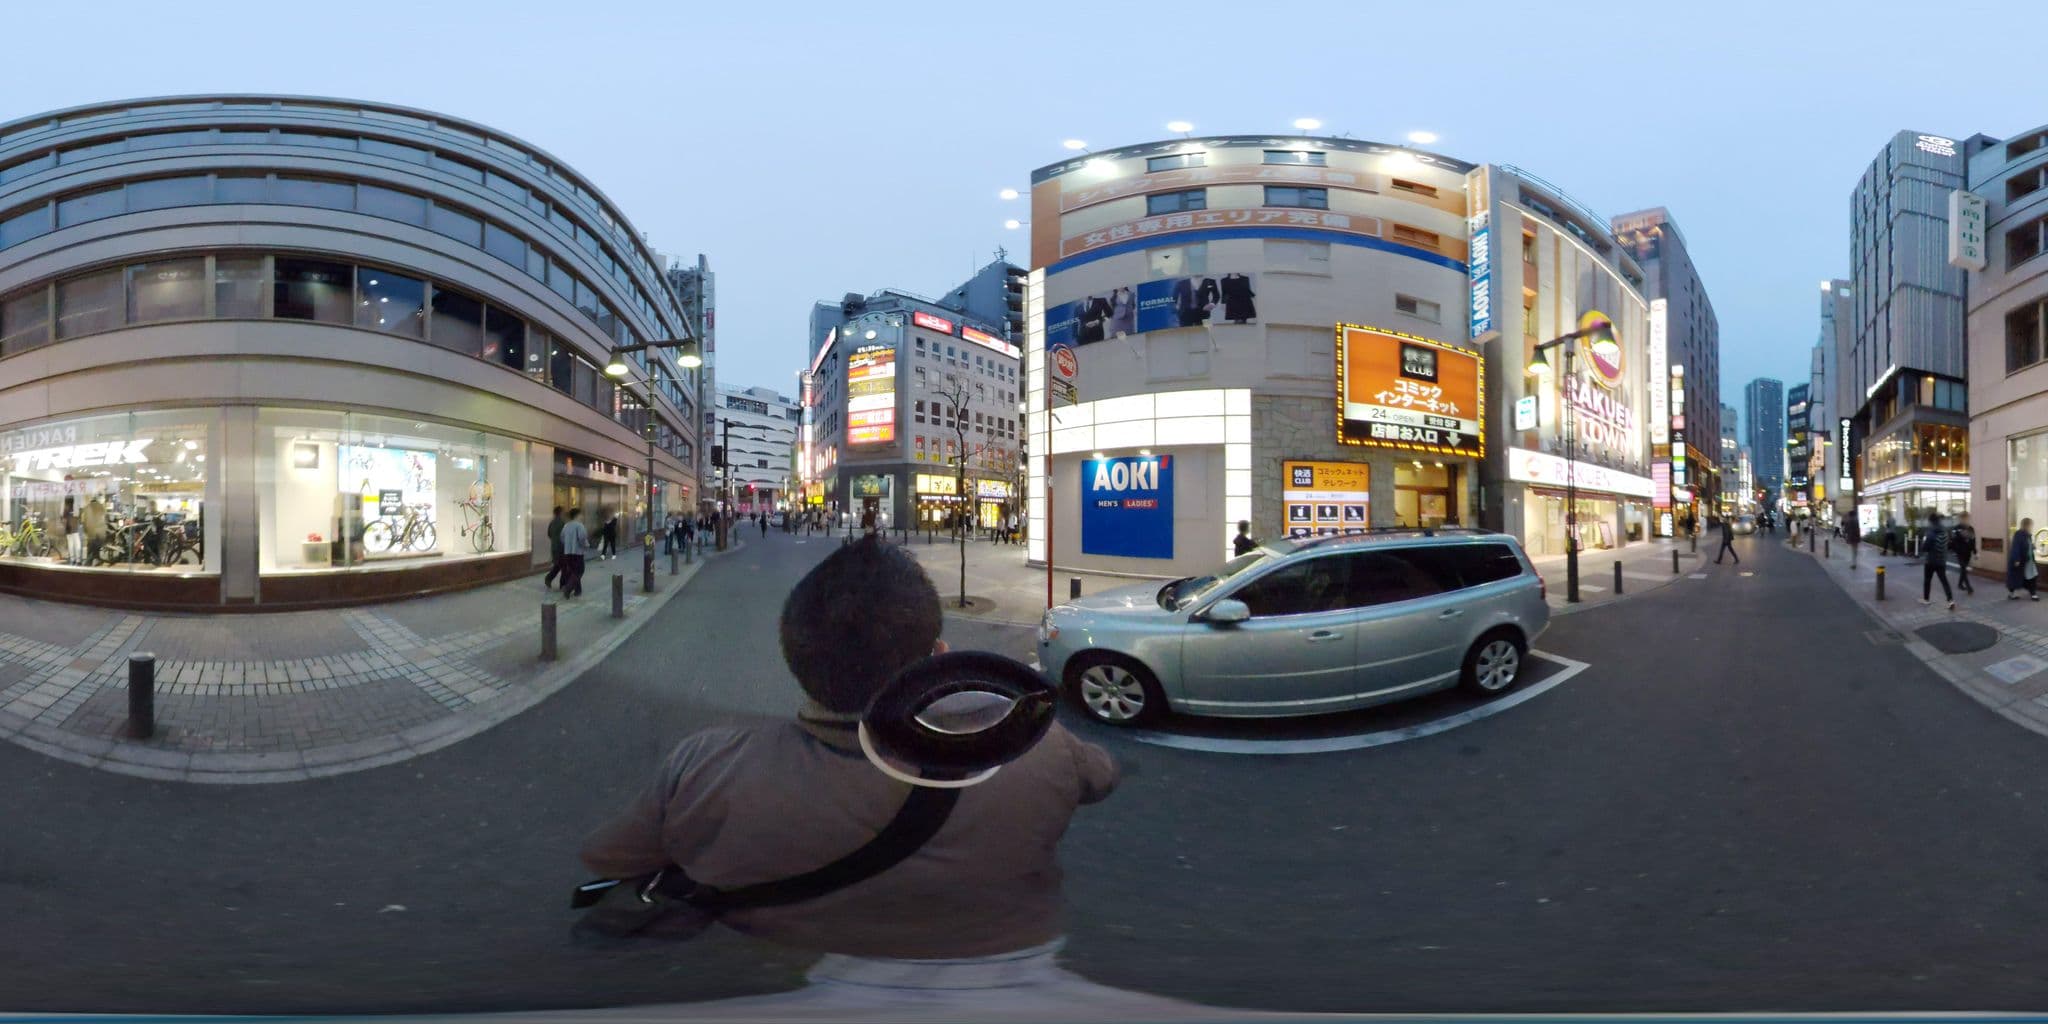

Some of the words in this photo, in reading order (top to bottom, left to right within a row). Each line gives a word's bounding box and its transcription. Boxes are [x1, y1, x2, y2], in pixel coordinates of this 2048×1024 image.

[1083, 210, 1350, 247] 女性専用エリア完備
[1140, 296, 1176, 306] FORMAL
[1473, 280, 1489, 320] AOKI
[1404, 364, 1434, 377] CLUB
[1374, 391, 1459, 415] インターネット
[1394, 379, 1442, 398] コミック
[1561, 374, 1632, 429] RAKUEN
[1371, 423, 1438, 443] 店舗お入口
[1579, 415, 1632, 454] TOWN
[11, 439, 154, 472] TREK
[1093, 461, 1158, 491] AOKI
